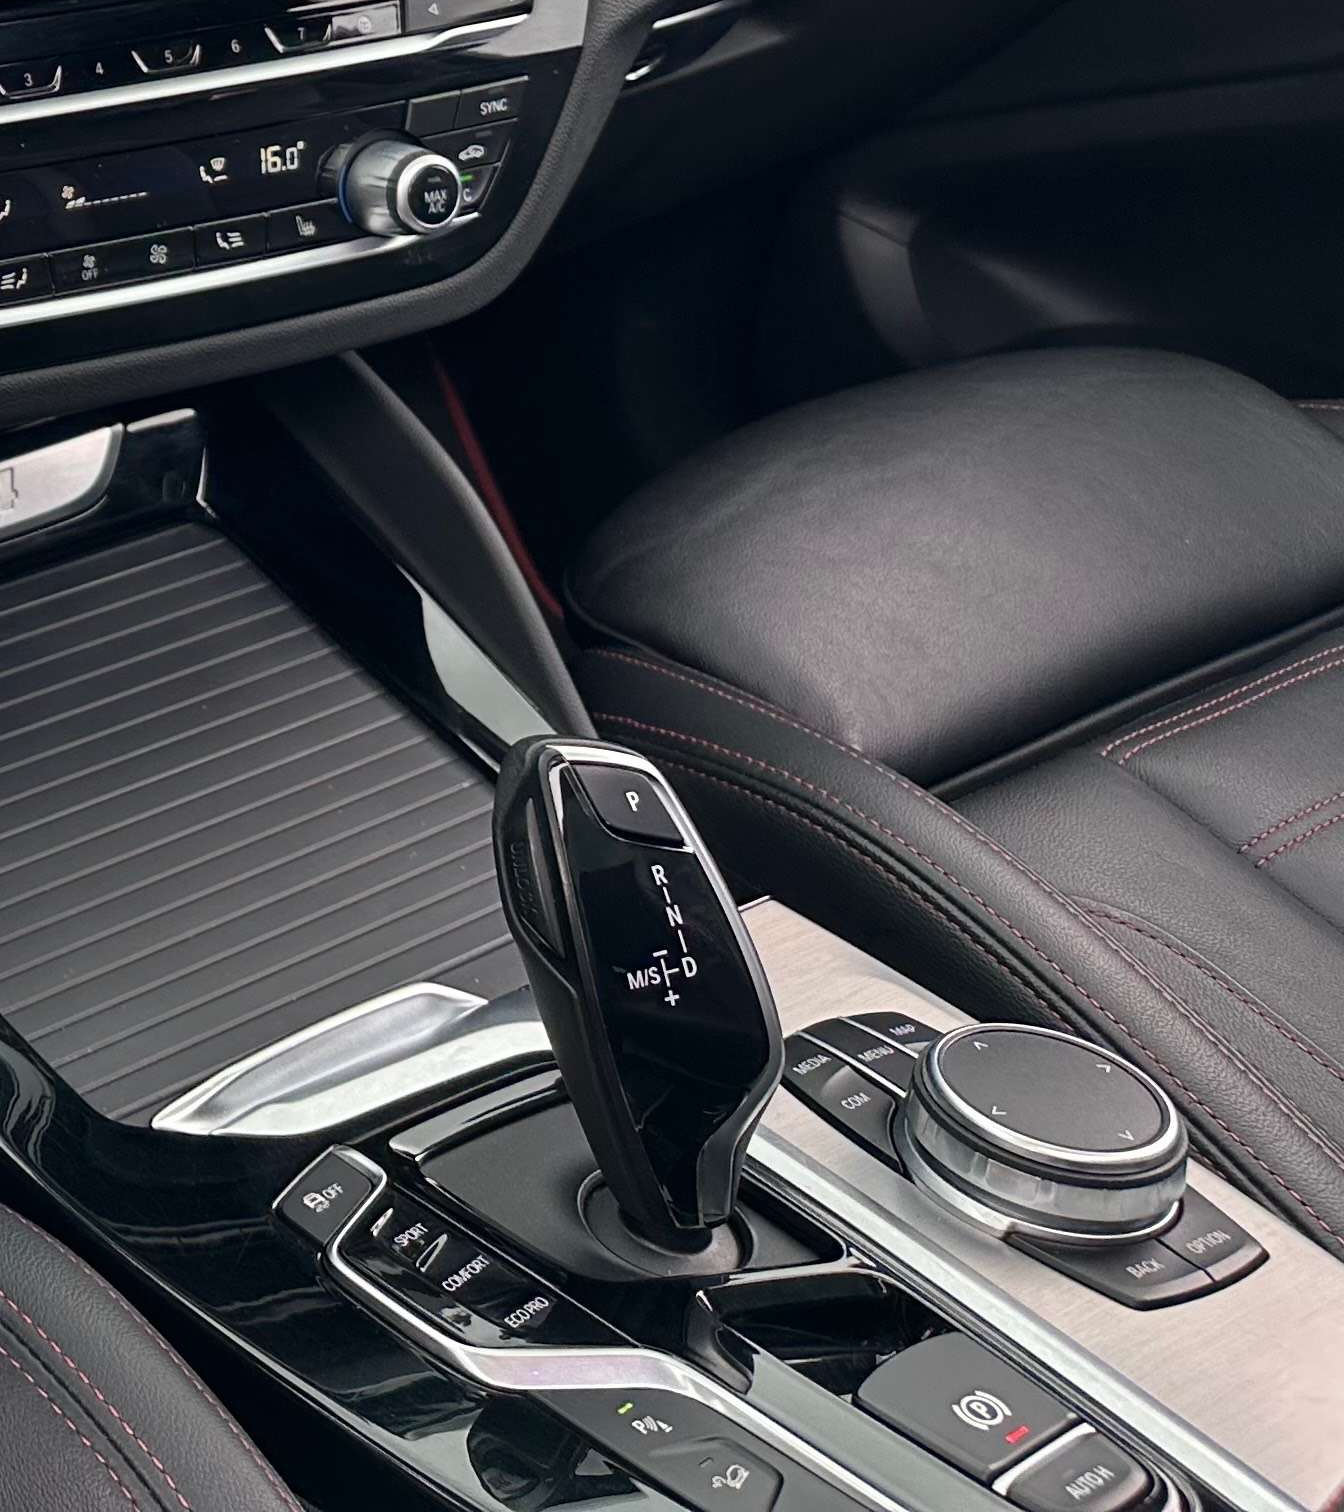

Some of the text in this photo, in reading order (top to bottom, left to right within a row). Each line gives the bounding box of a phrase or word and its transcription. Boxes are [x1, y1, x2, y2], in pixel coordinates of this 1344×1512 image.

[24, 72, 34, 87] 3
[95, 61, 104, 76] 4
[164, 48, 173, 64] 5
[231, 38, 241, 54] 6
[297, 26, 306, 42] 7
[480, 97, 508, 116] SYNC
[424, 188, 448, 204] MAX
[428, 201, 446, 215] A/C
[81, 267, 99, 281] OFF
[625, 790, 640, 812] P
[651, 864, 668, 886] R
[666, 904, 683, 927] N
[627, 955, 698, 990] M/S D
[889, 1024, 916, 1037] MAP
[792, 1053, 832, 1076] MEDIA
[857, 1044, 895, 1063] MENU
[840, 1092, 871, 1110] COM
[324, 1182, 344, 1201] OFF
[394, 1222, 429, 1248] SPORT
[1184, 1230, 1232, 1255] OPTION
[441, 1254, 491, 1292] COMFORT
[1125, 1257, 1166, 1280] BACK
[504, 1295, 550, 1329] ECO PRO
[1065, 1464, 1115, 1501] AUTO H
